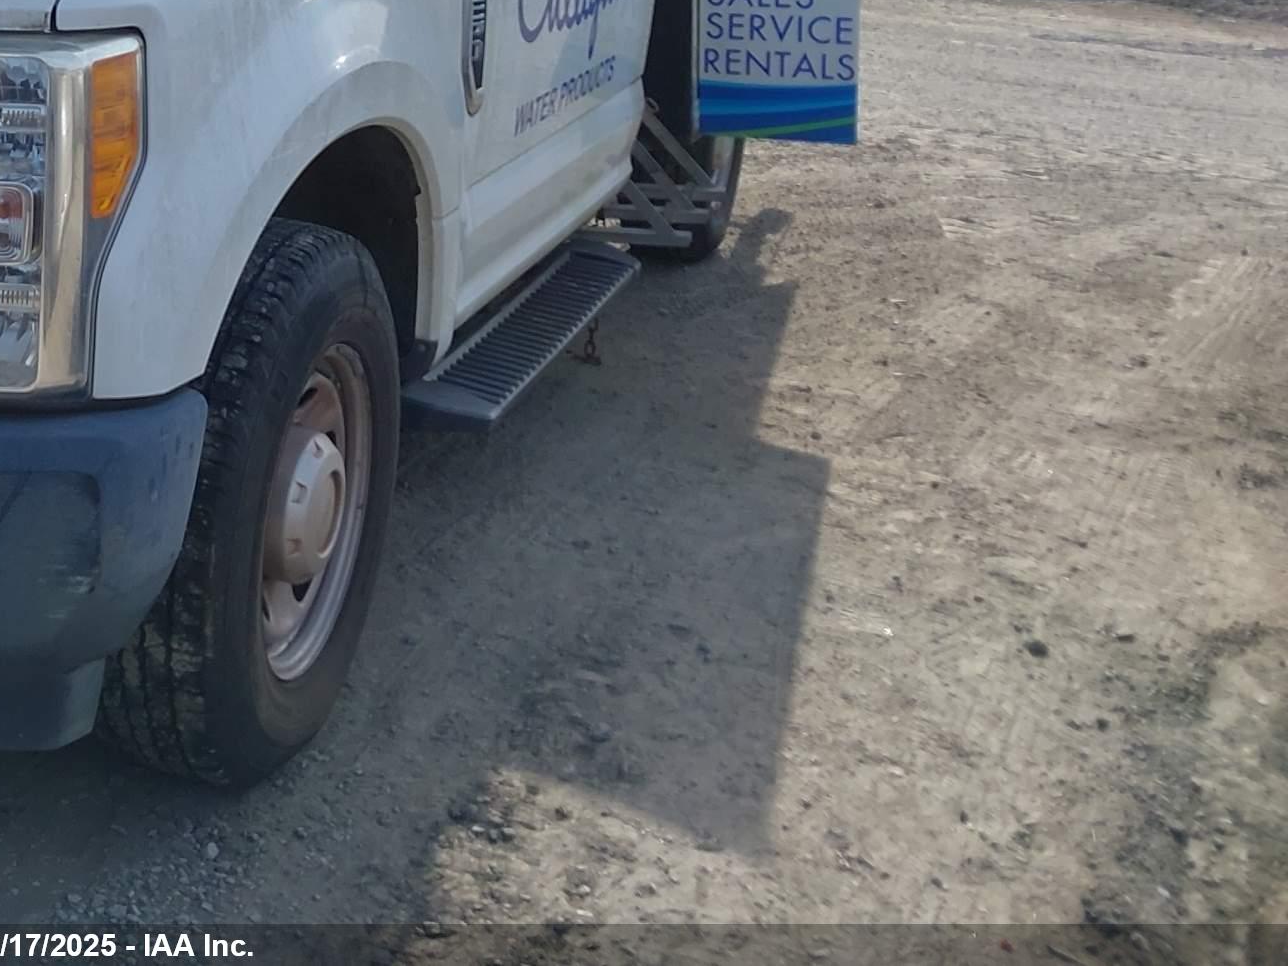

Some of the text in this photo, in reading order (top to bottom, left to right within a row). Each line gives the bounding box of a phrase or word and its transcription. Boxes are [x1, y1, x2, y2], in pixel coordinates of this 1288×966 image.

[706, 12, 854, 45] SERVICE
[703, 48, 855, 80] RENTALS
[514, 55, 616, 137] WATER PRODUCTS
